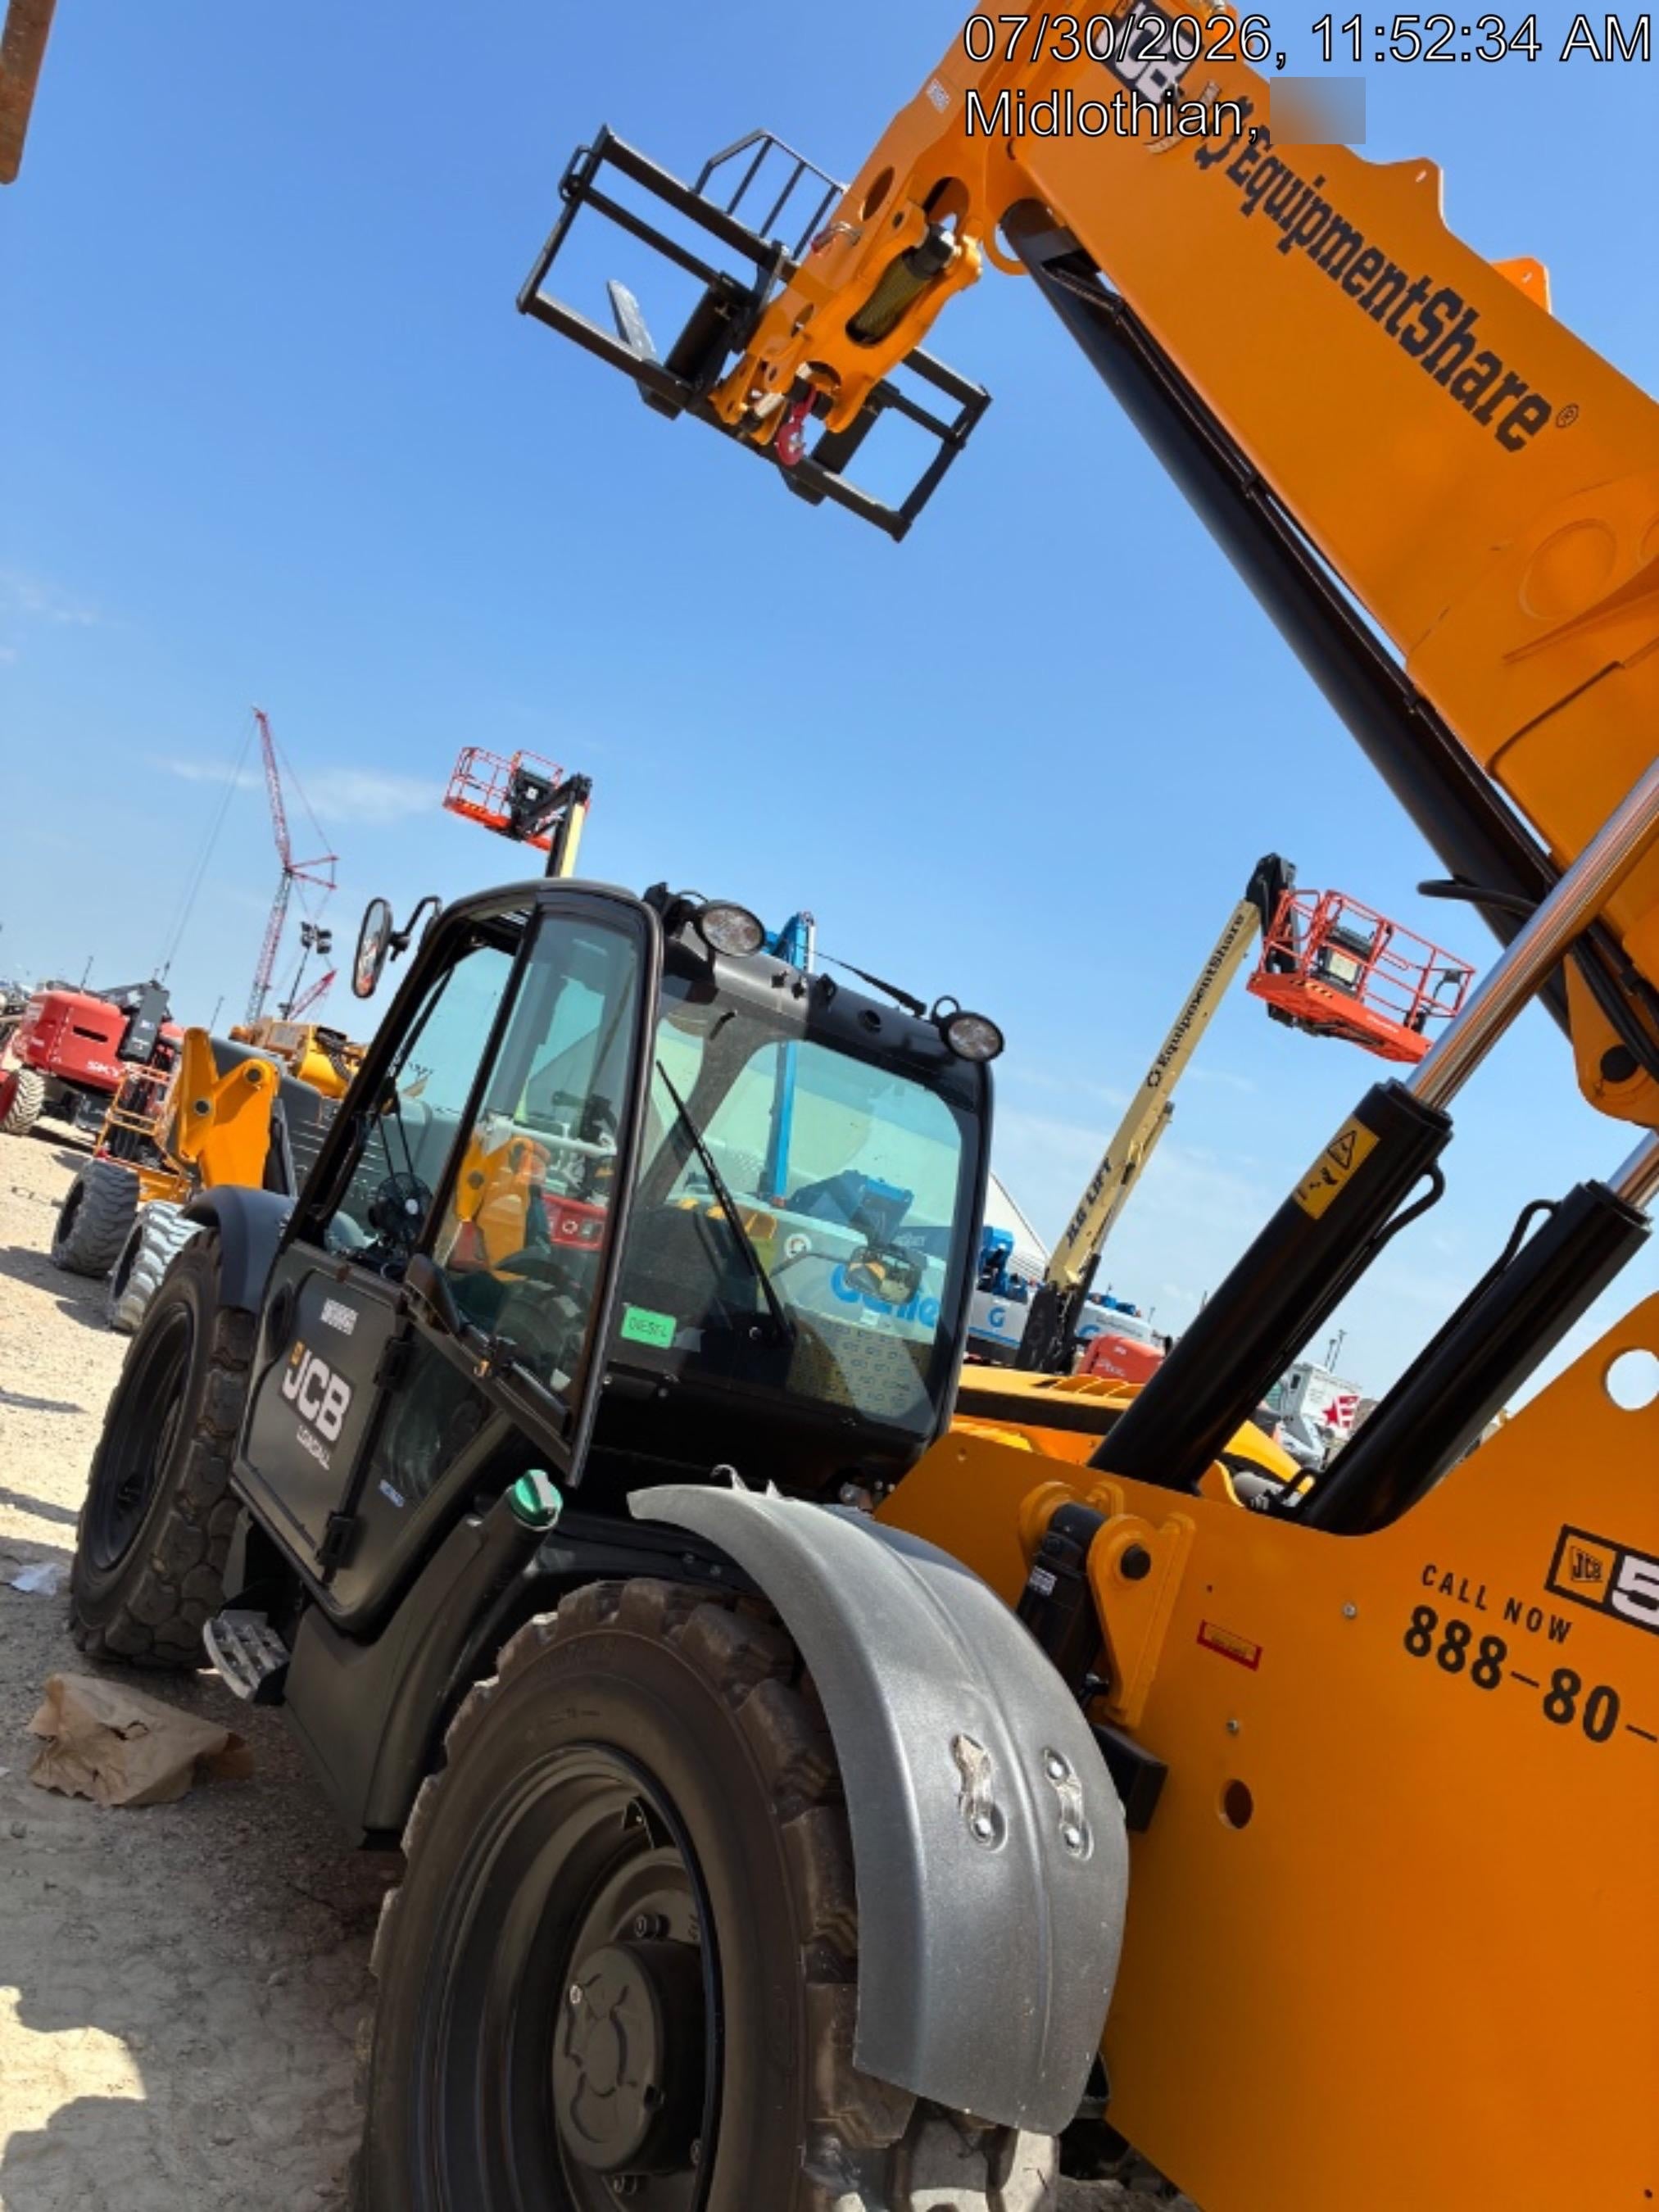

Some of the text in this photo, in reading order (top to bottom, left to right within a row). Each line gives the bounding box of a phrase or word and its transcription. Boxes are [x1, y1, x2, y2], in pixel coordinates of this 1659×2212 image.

[1157, 913, 1245, 1067] EquipmentShare
[1086, 1157, 1112, 1205] LIFT
[282, 1349, 352, 1442] JCB
[1421, 1564, 1573, 1644] CALL NOW
[1571, 1550, 1602, 1581] JCB
